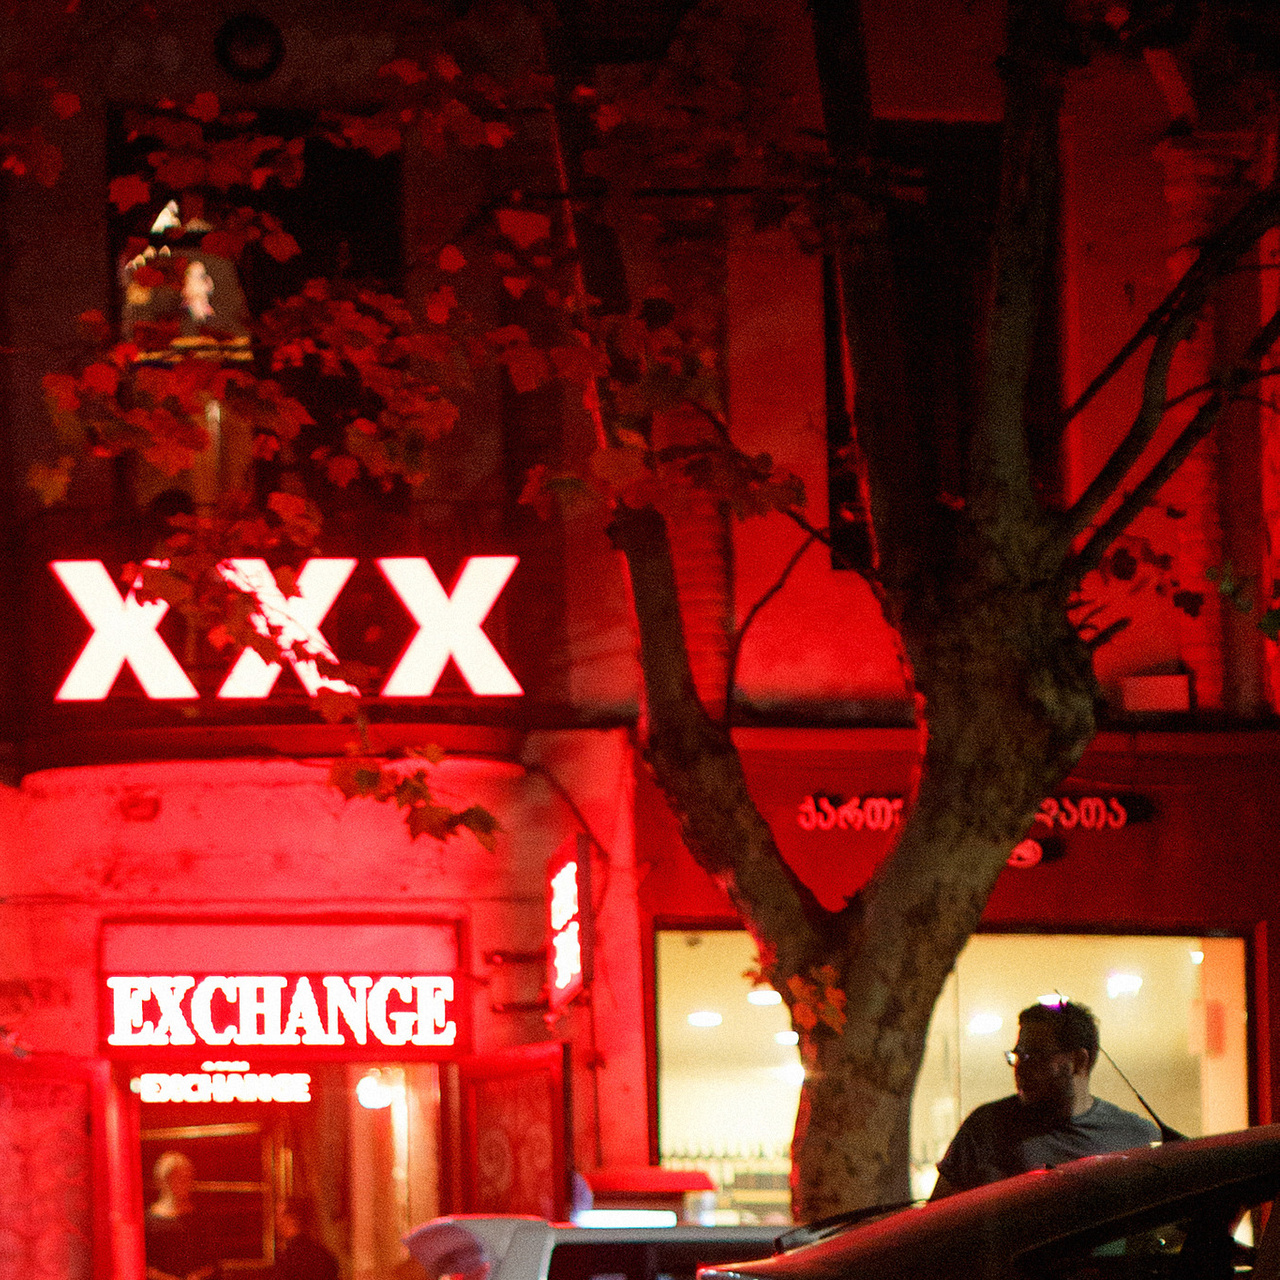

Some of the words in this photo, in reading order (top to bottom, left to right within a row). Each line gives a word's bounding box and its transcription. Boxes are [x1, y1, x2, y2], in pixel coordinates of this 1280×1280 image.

[50, 555, 526, 701] XXX
[797, 794, 904, 832] ქართ
[107, 975, 457, 1046] EXCHANGE
[139, 1072, 312, 1103] EXCHANGE
